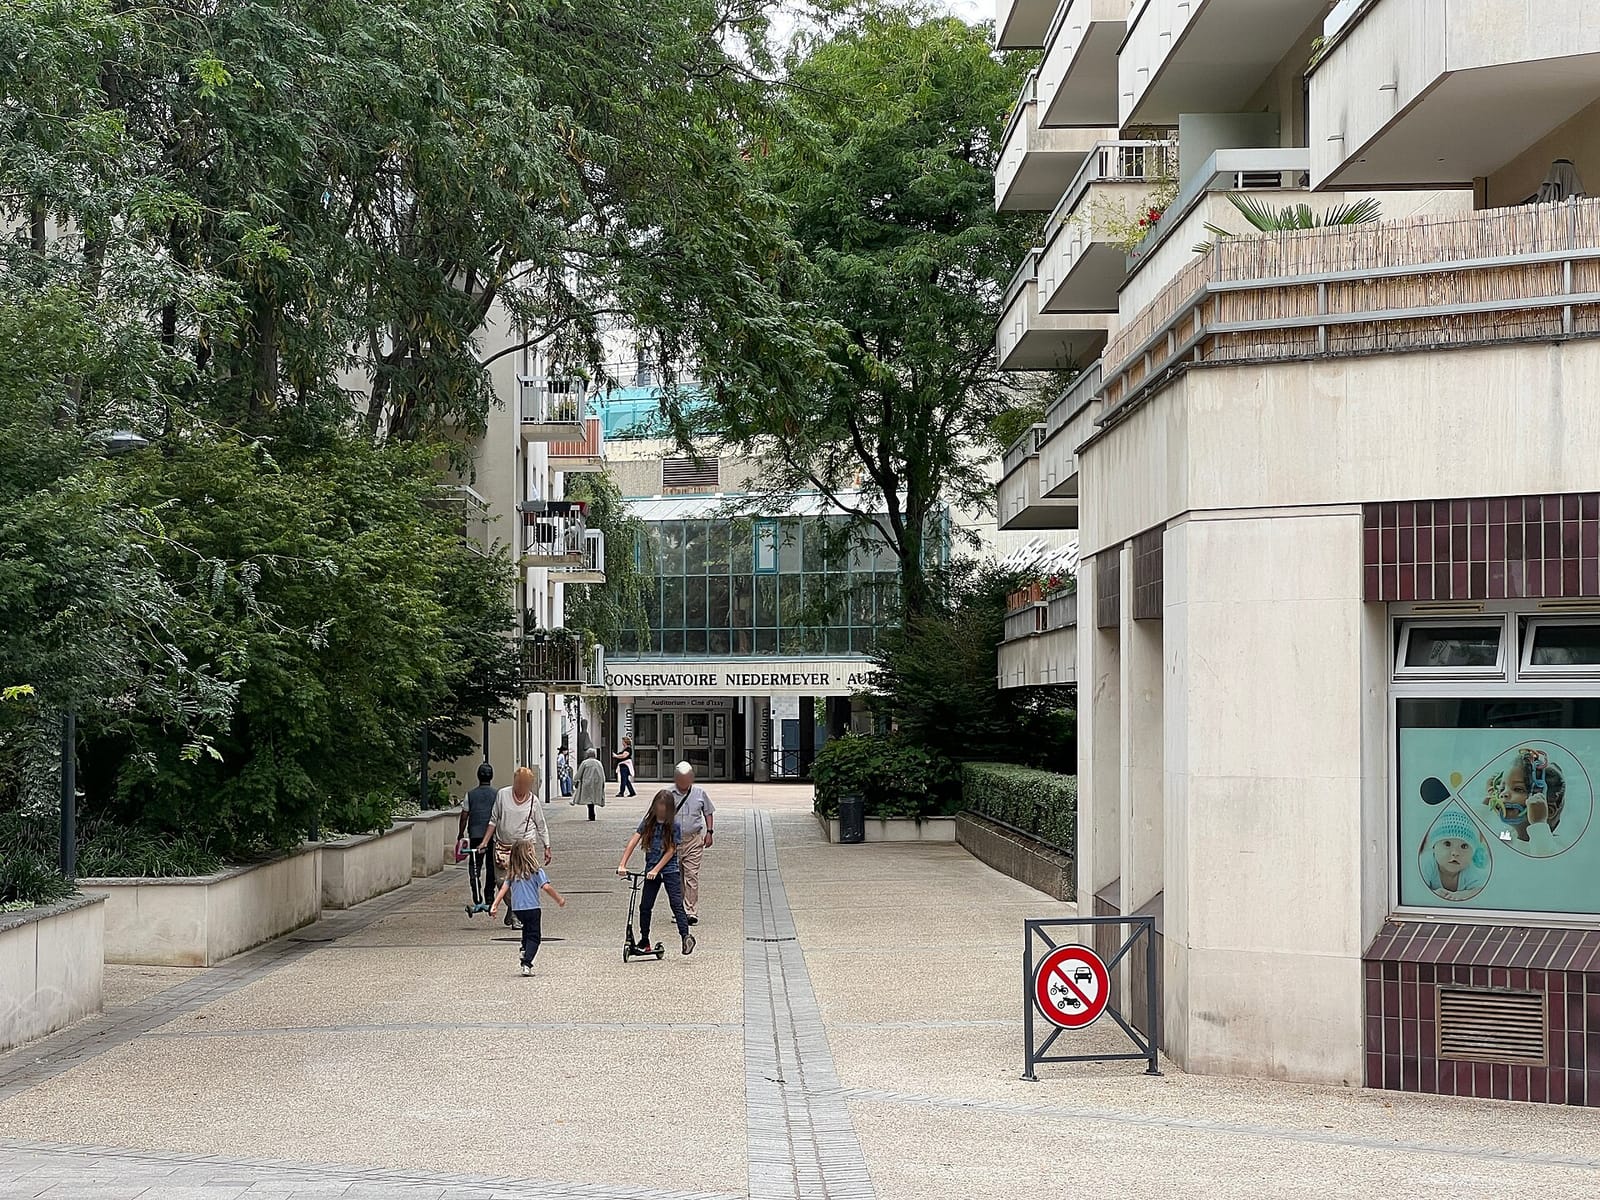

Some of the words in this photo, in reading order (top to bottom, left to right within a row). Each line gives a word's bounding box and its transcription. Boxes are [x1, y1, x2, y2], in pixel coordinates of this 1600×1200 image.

[605, 673, 717, 686] CONSERVATOIRE
[726, 673, 830, 686] NIEDERMEYER
[760, 708, 768, 764] Auditorium
